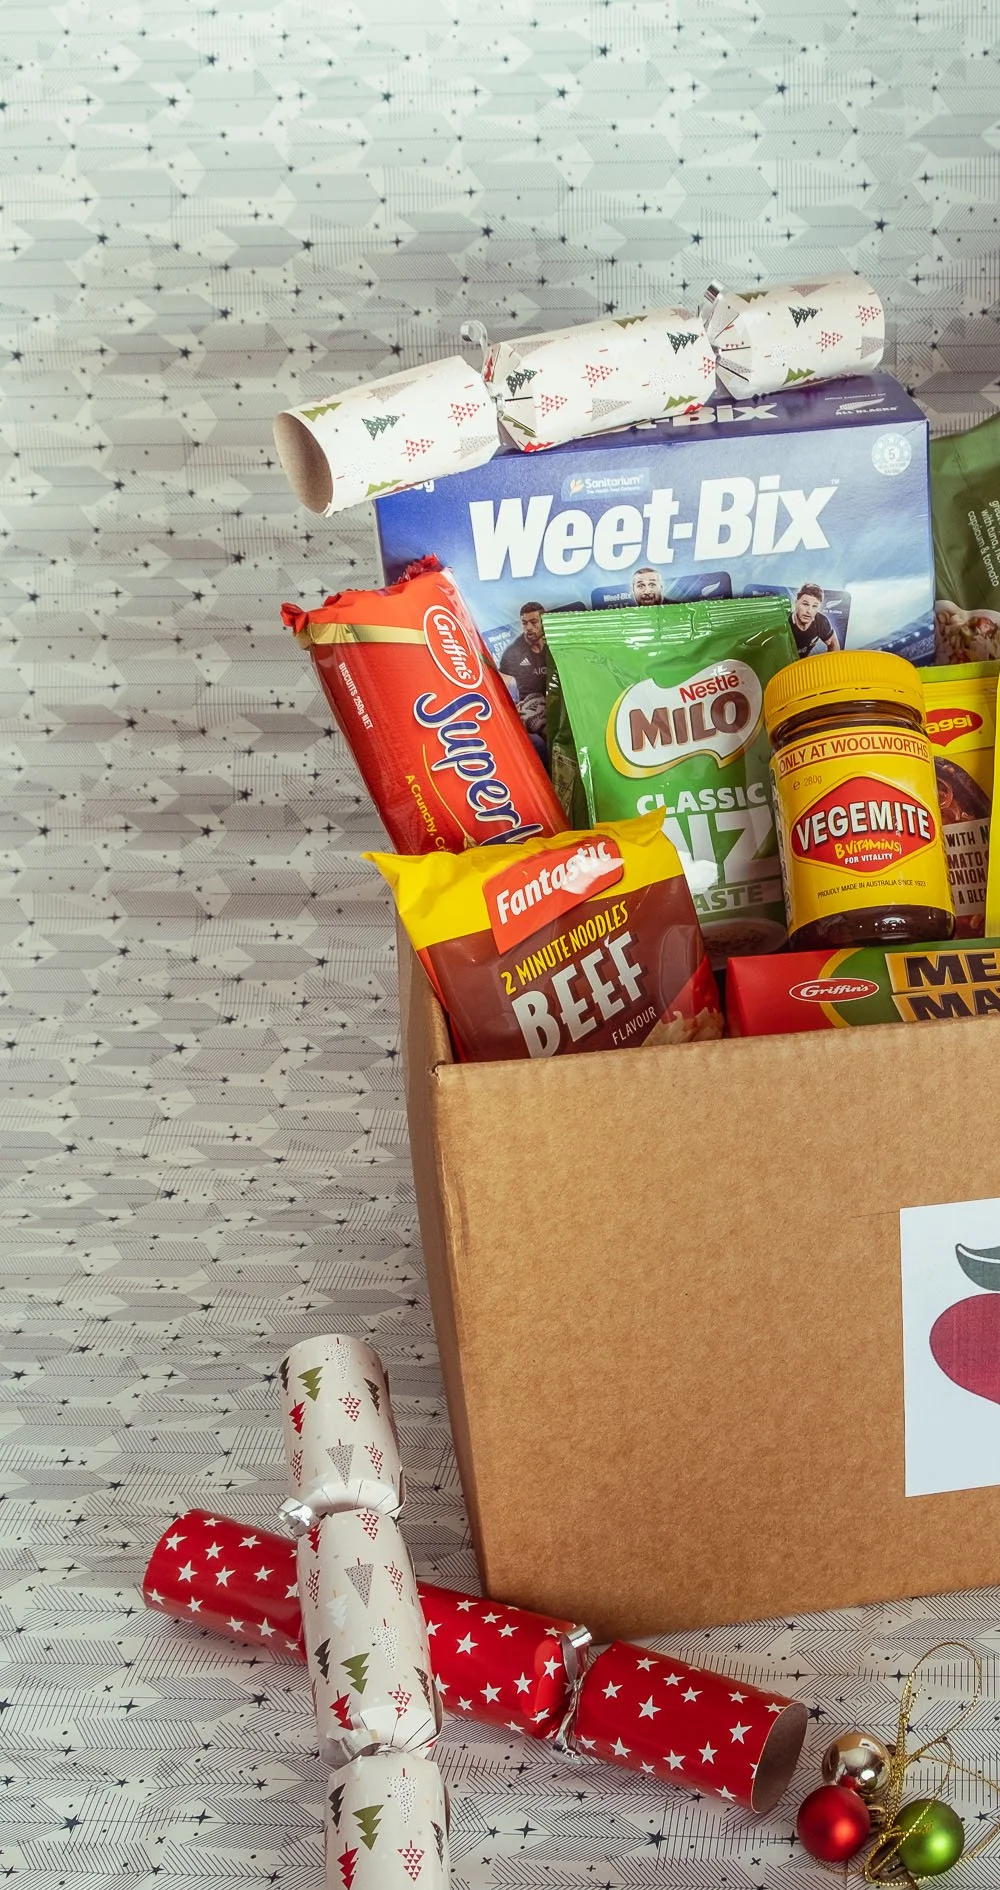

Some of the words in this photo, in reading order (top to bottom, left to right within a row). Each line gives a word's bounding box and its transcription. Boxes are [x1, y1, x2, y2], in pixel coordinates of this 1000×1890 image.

[584, 475, 641, 490] Sanitarium
[469, 475, 838, 581] Weet-Bix
[968, 510, 985, 548] capsicum
[981, 509, 993, 527] with
[987, 526, 999, 549] tuna,
[980, 546, 990, 555] &
[983, 554, 999, 587] tomato
[433, 613, 474, 681] Griffin's
[338, 661, 358, 697] BISCUITS
[352, 696, 365, 716] 250g
[360, 715, 374, 730] NET
[628, 690, 751, 752] MILO
[925, 714, 972, 733] aggi
[779, 751, 809, 772] ONLY
[810, 742, 827, 759] AT
[830, 737, 928, 759] WOOLWORTHS
[804, 775, 822, 787] 280g
[405, 775, 415, 784] A
[411, 784, 437, 836] Crunchy,
[636, 783, 767, 816] CLASSIC
[796, 801, 931, 850] VEGEMITE
[945, 831, 976, 847] WITH
[835, 844, 844, 859] B
[845, 856, 859, 864] FOR
[861, 853, 893, 862] VITALITY
[947, 851, 983, 869] MATO
[497, 841, 611, 925] Fantastic
[693, 885, 763, 912] ASTE
[817, 886, 840, 898] PROUDLY
[841, 883, 857, 892] MADE
[865, 879, 897, 888] AUSTRALIA
[501, 971, 517, 995] 2
[515, 935, 572, 986] MINUTE
[569, 901, 629, 952] NOODLES
[512, 931, 643, 1059] BEEF
[800, 983, 870, 998] Griffin's
[612, 1006, 658, 1045] FLAVOUR
